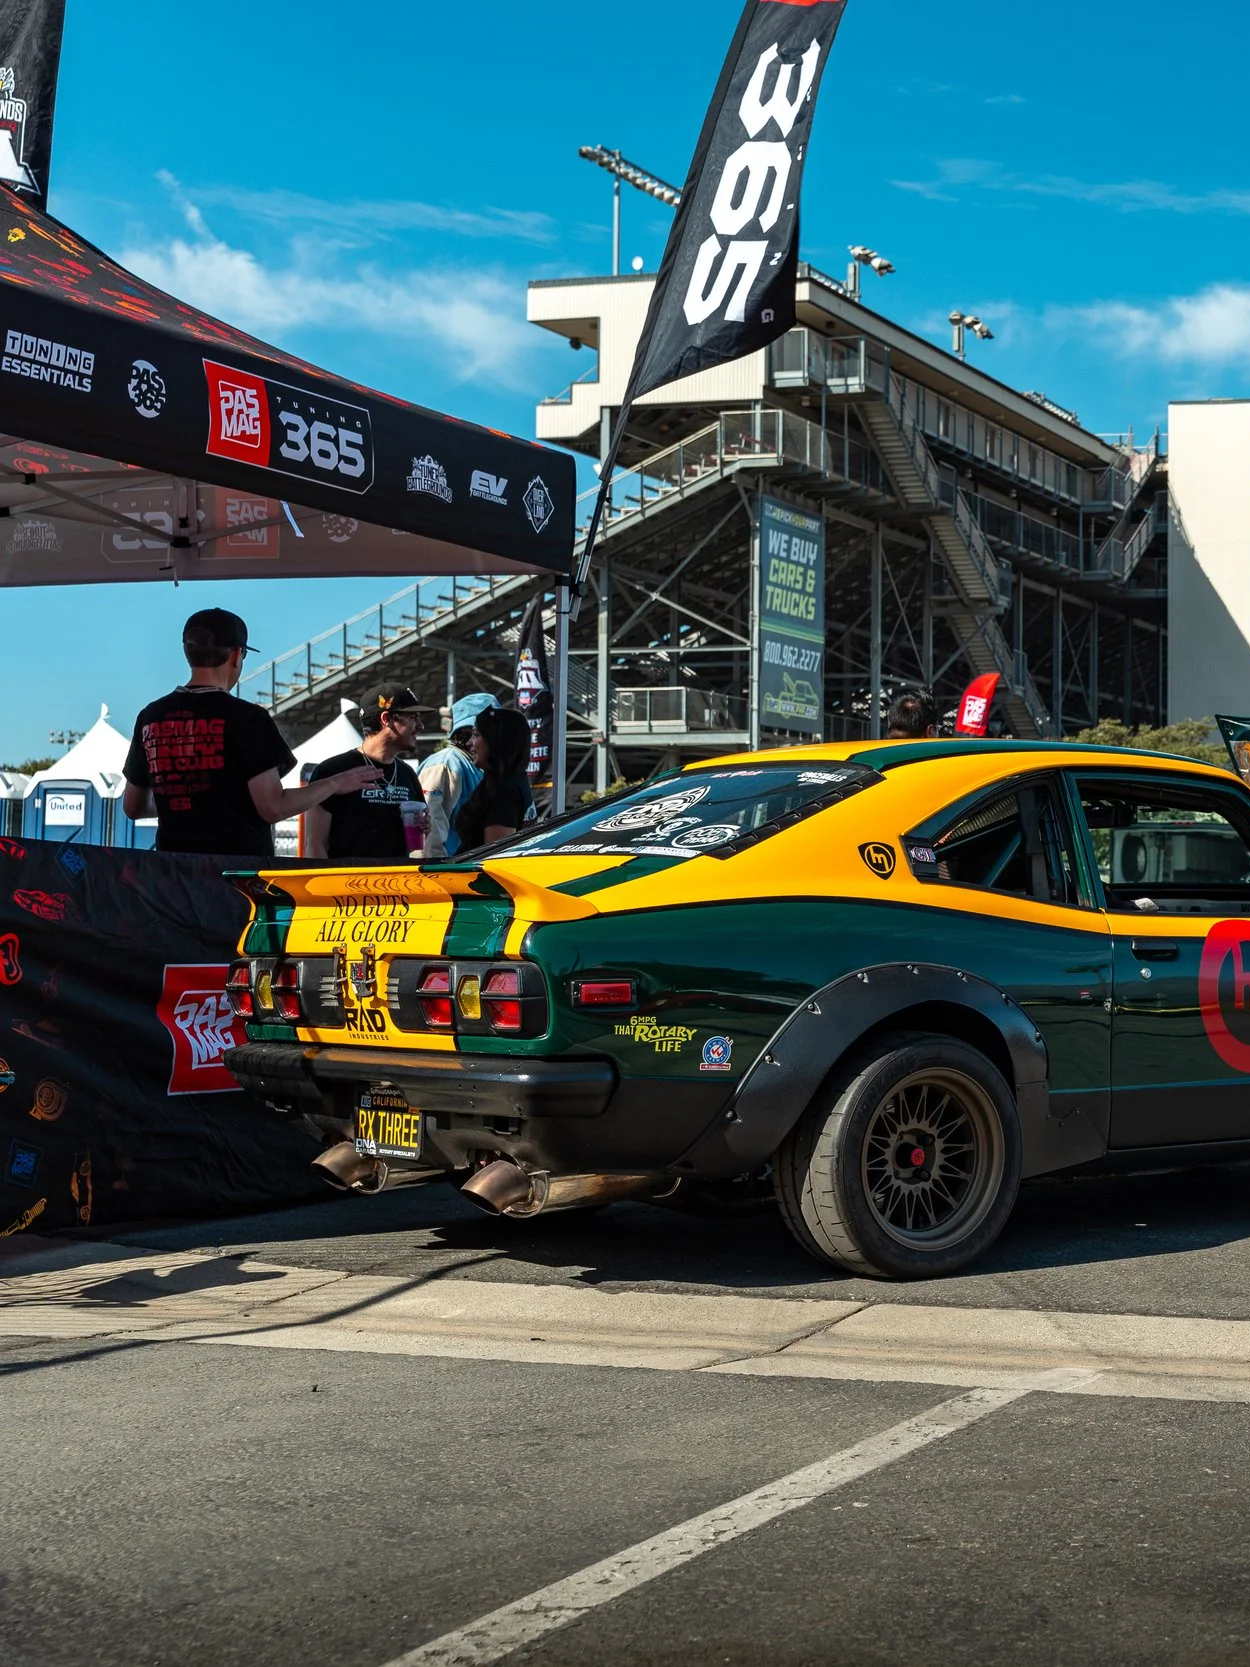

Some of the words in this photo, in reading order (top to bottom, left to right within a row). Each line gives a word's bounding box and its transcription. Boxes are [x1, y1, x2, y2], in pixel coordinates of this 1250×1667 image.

[683, 38, 821, 325] 365
[6, 331, 94, 374] TUNING
[1, 356, 92, 393] ESSENTIALS
[131, 365, 164, 392] PAS
[132, 386, 166, 414] 365
[220, 389, 260, 416] PAS
[276, 396, 362, 428] TUNING
[221, 412, 260, 440] MAG
[278, 410, 365, 478] 365
[470, 470, 508, 497] EV
[769, 529, 789, 558] WE
[790, 536, 818, 566] BUY
[769, 558, 803, 590] CARS
[806, 569, 816, 593] &
[766, 585, 816, 621] TRUCKS
[763, 640, 821, 672] 800.962.2277
[142, 719, 225, 742] PASMAG
[50, 802, 82, 811] United
[362, 788, 385, 799] GR
[332, 895, 357, 917] NO
[362, 895, 411, 917] GUTS
[315, 920, 346, 942] ALL
[352, 920, 416, 942] GLORY
[345, 1003, 386, 1033] RAD
[349, 1033, 389, 1041] INDUSTRIES
[614, 1025, 635, 1035] THAT
[634, 1025, 698, 1042] ROTARY
[655, 1041, 682, 1052] LIFE
[373, 1096, 407, 1108] CALIFORNIA
[358, 1109, 375, 1140] RX
[378, 1111, 420, 1148] THREE
[356, 1138, 376, 1149] DNA
